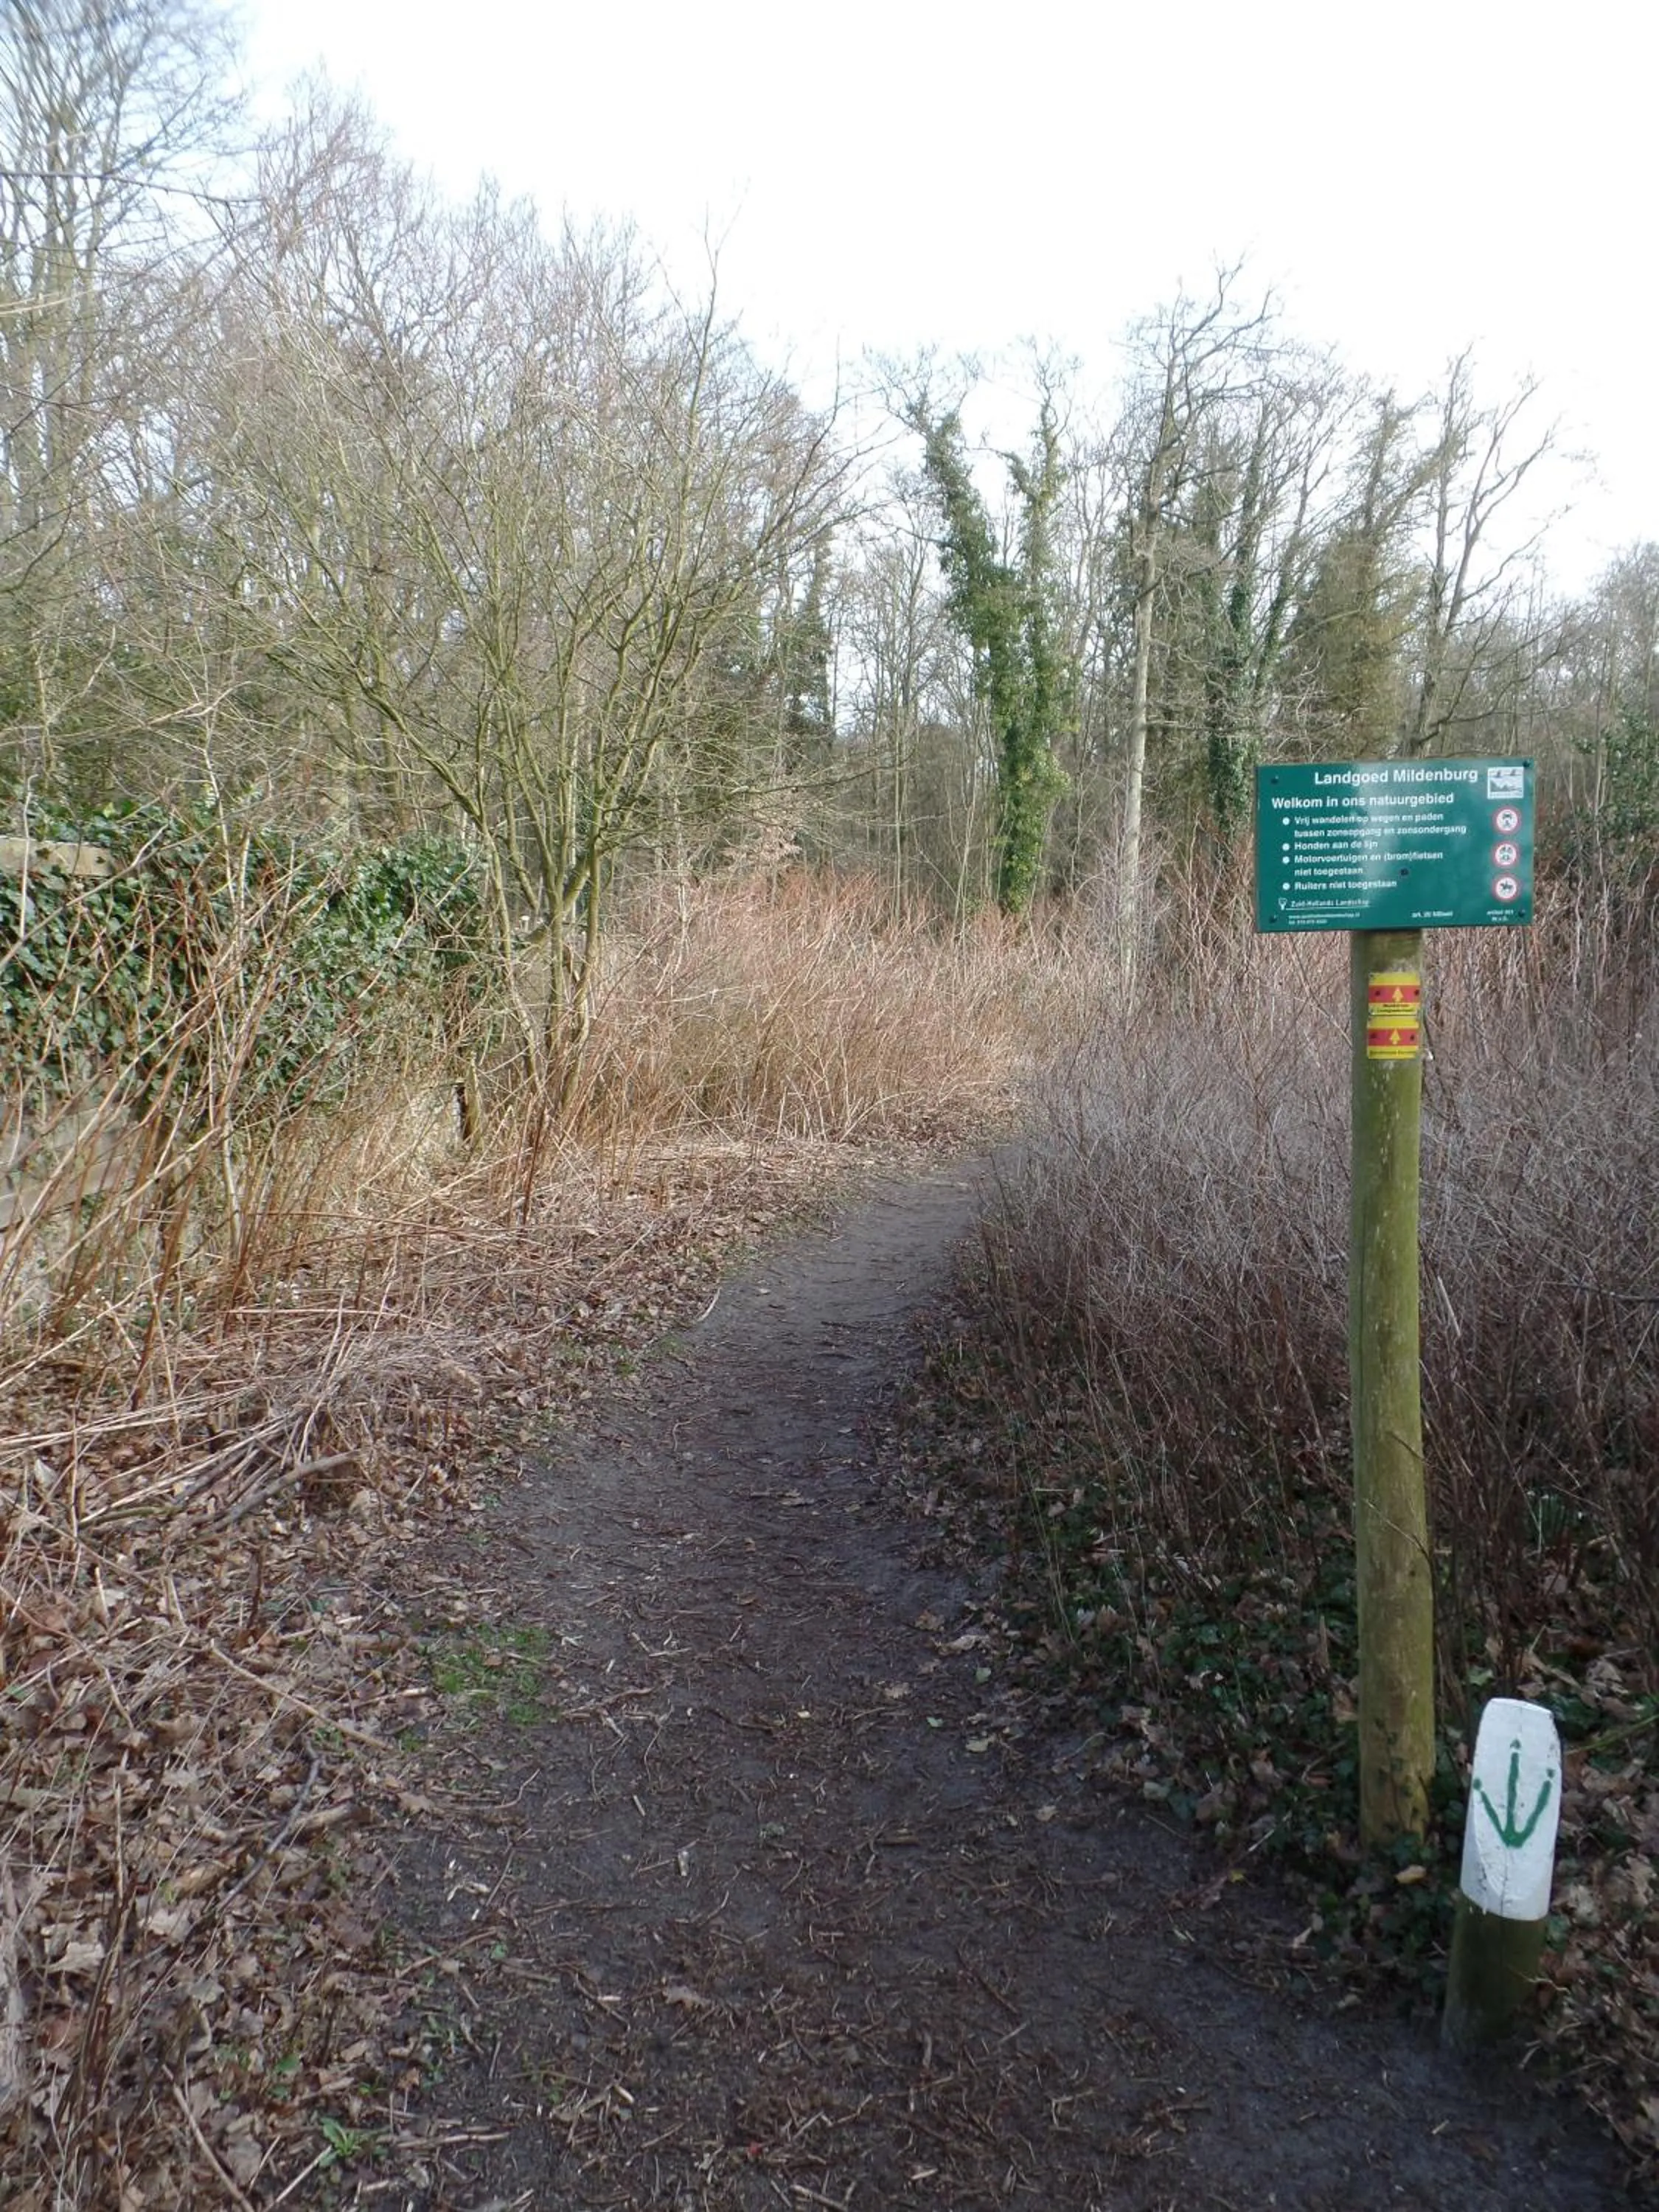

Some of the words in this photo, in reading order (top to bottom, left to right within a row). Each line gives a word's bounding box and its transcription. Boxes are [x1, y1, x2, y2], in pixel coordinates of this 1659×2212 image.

[1315, 770, 1388, 786] Landgoed
[1393, 768, 1478, 783] Mildenburg
[1272, 796, 1323, 810] Welkom
[1326, 796, 1338, 807] in
[1342, 797, 1366, 807] ons
[1370, 793, 1454, 807] natuurgebied
[1295, 816, 1310, 827] Vrij
[1312, 814, 1354, 824] wandelen
[1357, 815, 1368, 824] op
[1371, 813, 1399, 824] wegen
[1402, 813, 1413, 821] en
[1416, 812, 1444, 823] paden
[1295, 828, 1324, 838] tussen
[1326, 827, 1381, 838] zonsopgang
[1397, 824, 1467, 835] zonsondergang
[1295, 841, 1329, 849] Honden
[1332, 841, 1348, 849] aan
[1351, 840, 1362, 849] de
[1365, 840, 1378, 850] lijn
[1295, 853, 1368, 864] Motorvoertuigen
[1384, 851, 1443, 862] (brom)fietsen
[1295, 867, 1312, 876] niet
[1314, 867, 1363, 877] toegestaan
[1295, 881, 1326, 891] Ruiters
[1328, 880, 1346, 889] niet
[1348, 880, 1397, 890] toegestaan
